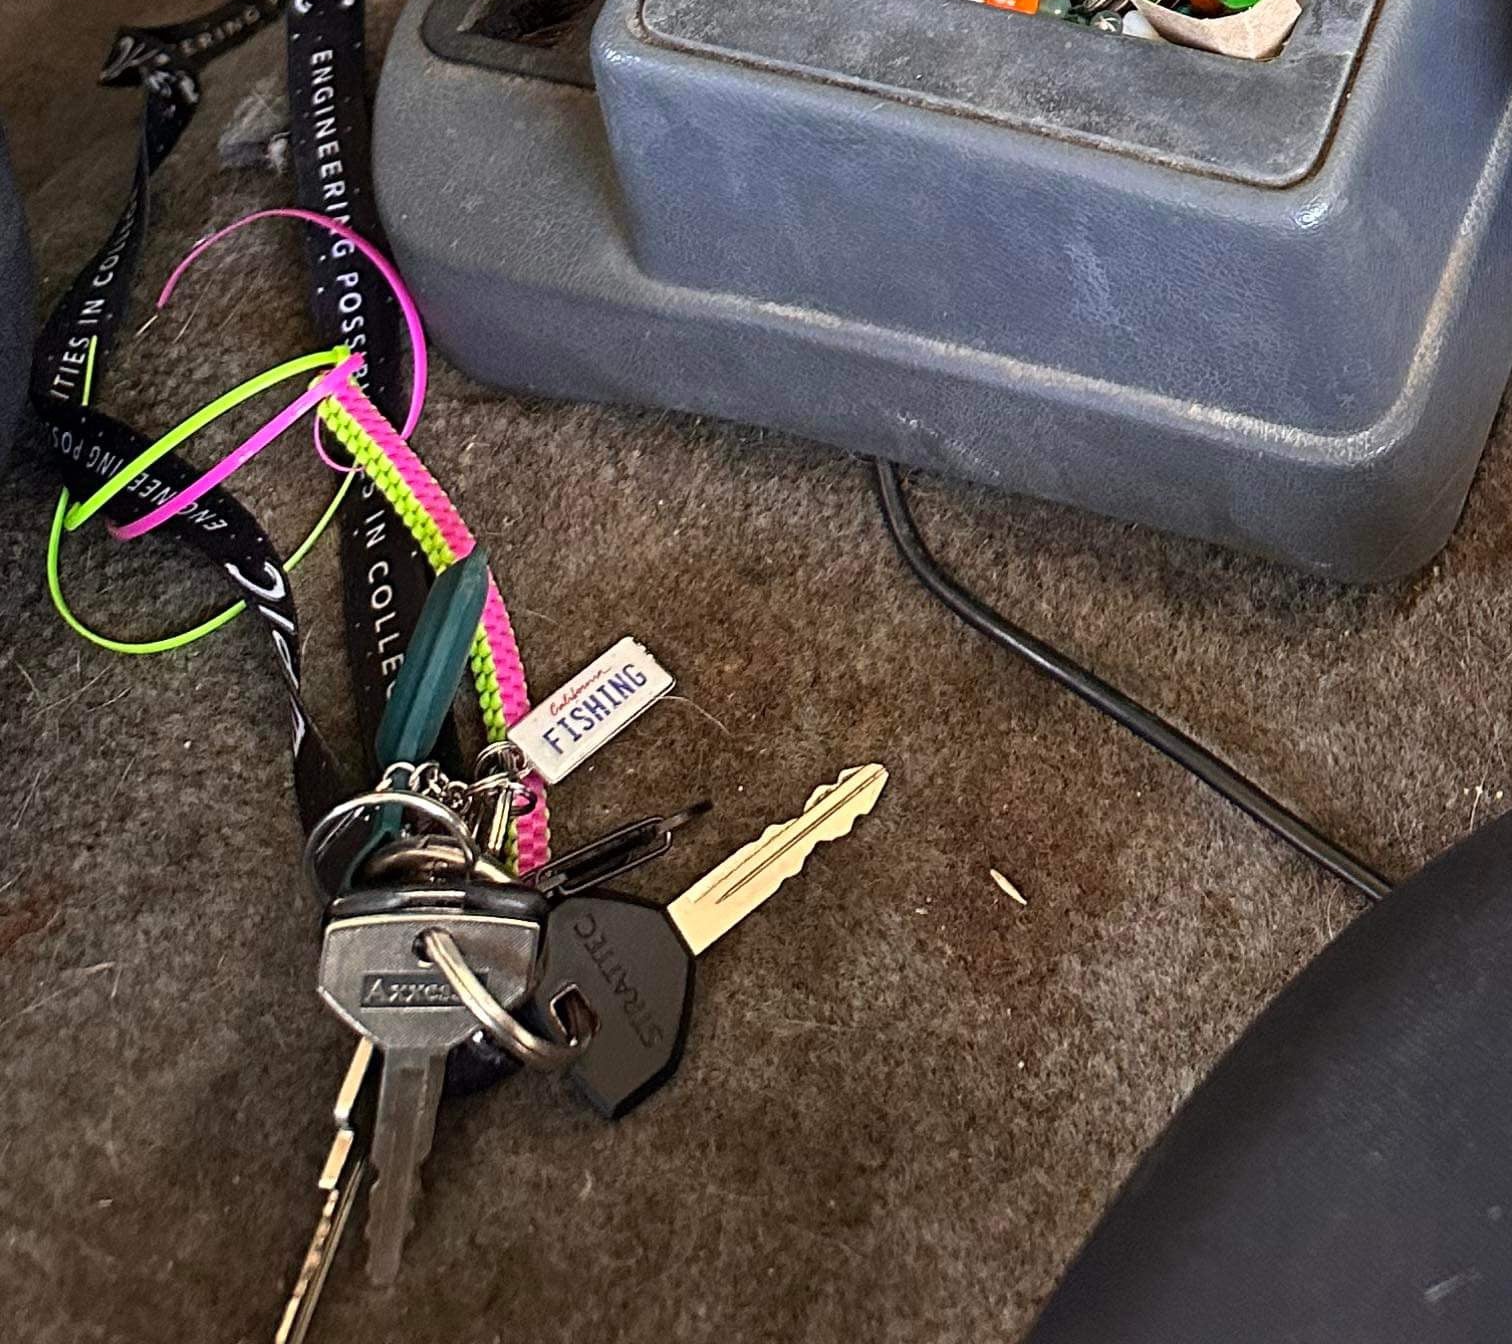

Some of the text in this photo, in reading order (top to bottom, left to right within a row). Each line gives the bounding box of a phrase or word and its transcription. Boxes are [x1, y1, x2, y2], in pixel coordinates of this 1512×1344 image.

[77, 298, 105, 324] IN
[364, 509, 387, 549] IN
[541, 663, 648, 755] FISHING
[550, 666, 613, 716] California
